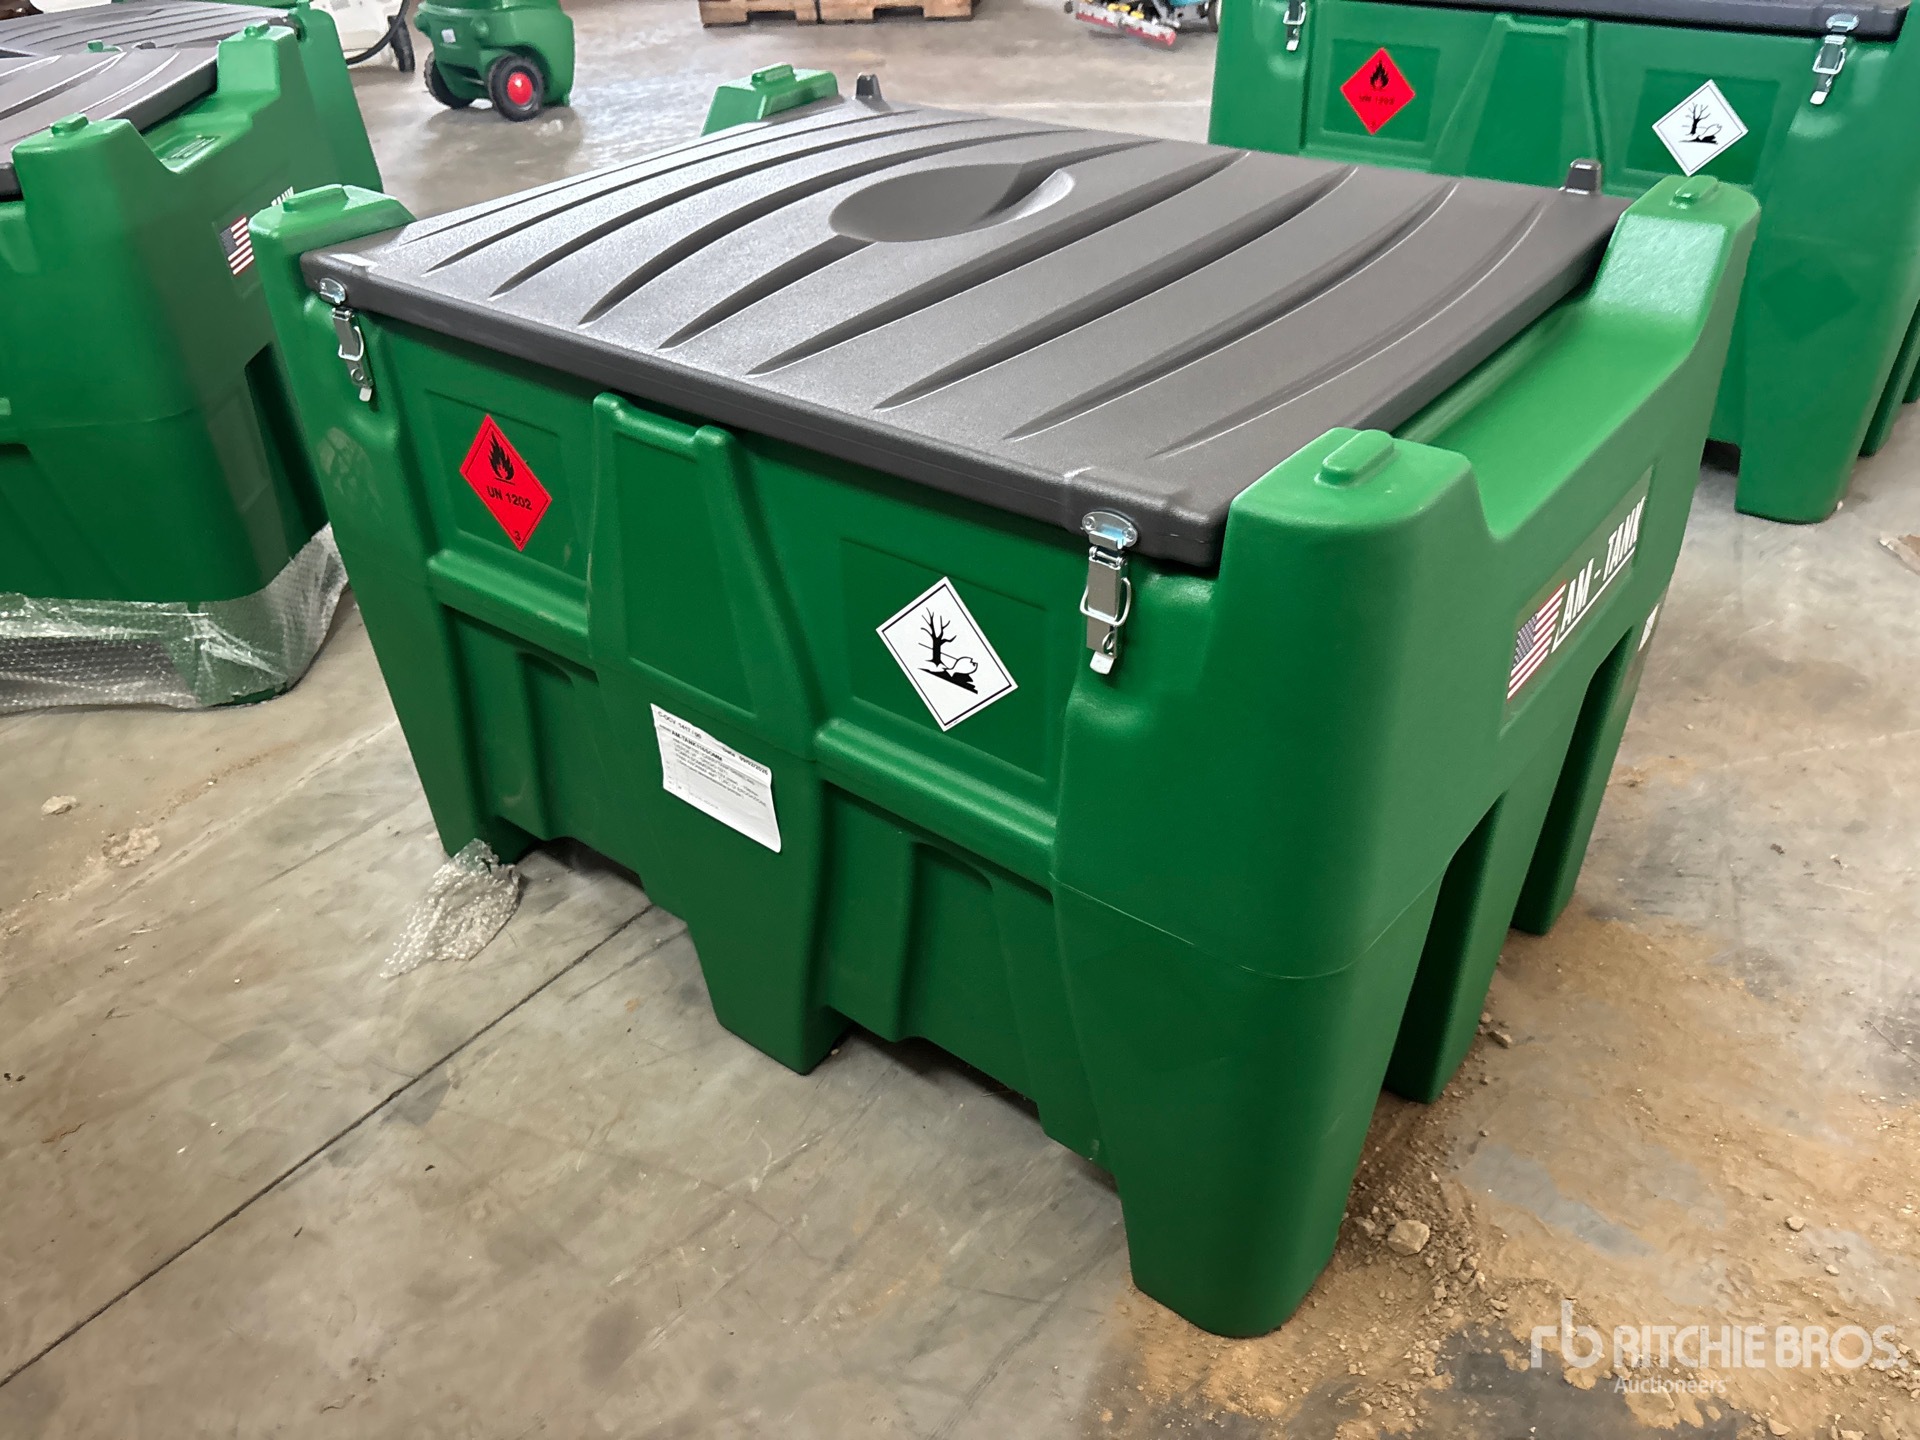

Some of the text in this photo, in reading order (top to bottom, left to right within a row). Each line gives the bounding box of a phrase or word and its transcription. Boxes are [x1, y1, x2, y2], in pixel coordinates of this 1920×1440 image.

[487, 485, 533, 511] UN 1202
[514, 530, 522, 542] 3
[1560, 557, 1595, 634] AM
